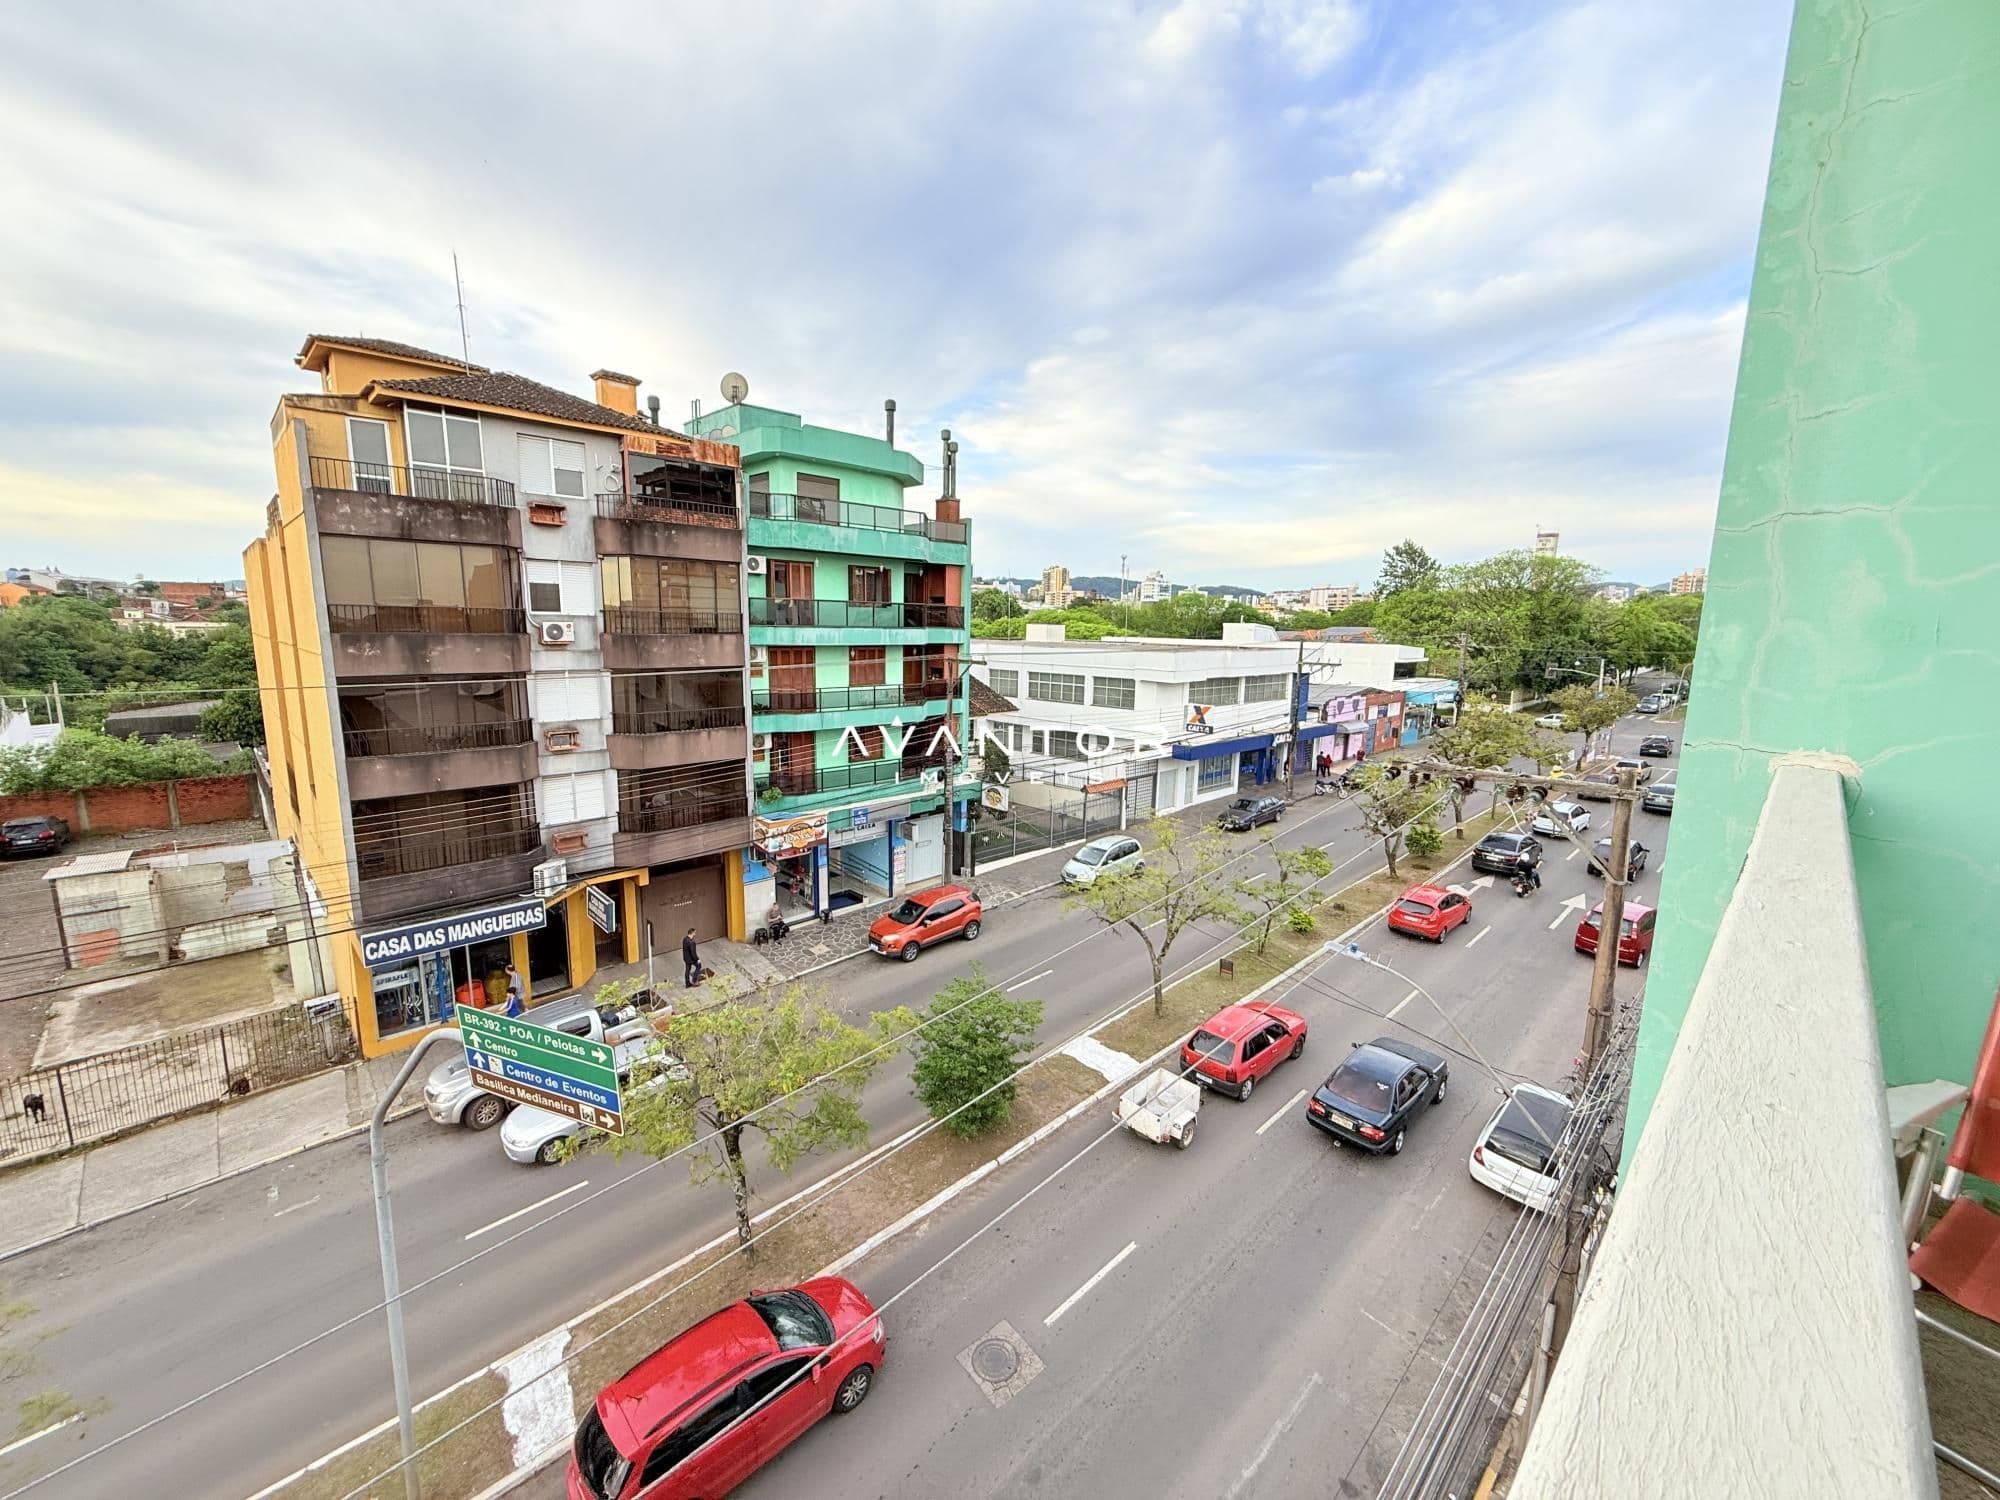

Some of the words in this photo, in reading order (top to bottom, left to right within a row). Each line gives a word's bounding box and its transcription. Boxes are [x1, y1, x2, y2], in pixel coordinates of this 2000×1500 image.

[1188, 725, 1210, 733] CAIXA
[365, 936, 412, 960] CASA
[413, 928, 446, 950] DAS
[447, 907, 544, 943] MANGUEIRAS
[463, 1013, 502, 1032] BR-392
[509, 1025, 536, 1042] POA
[543, 1035, 586, 1056] Pelotas
[484, 1039, 519, 1057] Centro
[506, 1065, 542, 1084] Centro
[545, 1077, 559, 1089] de
[562, 1081, 608, 1105] Eventos
[516, 1087, 575, 1114] Medianeira
